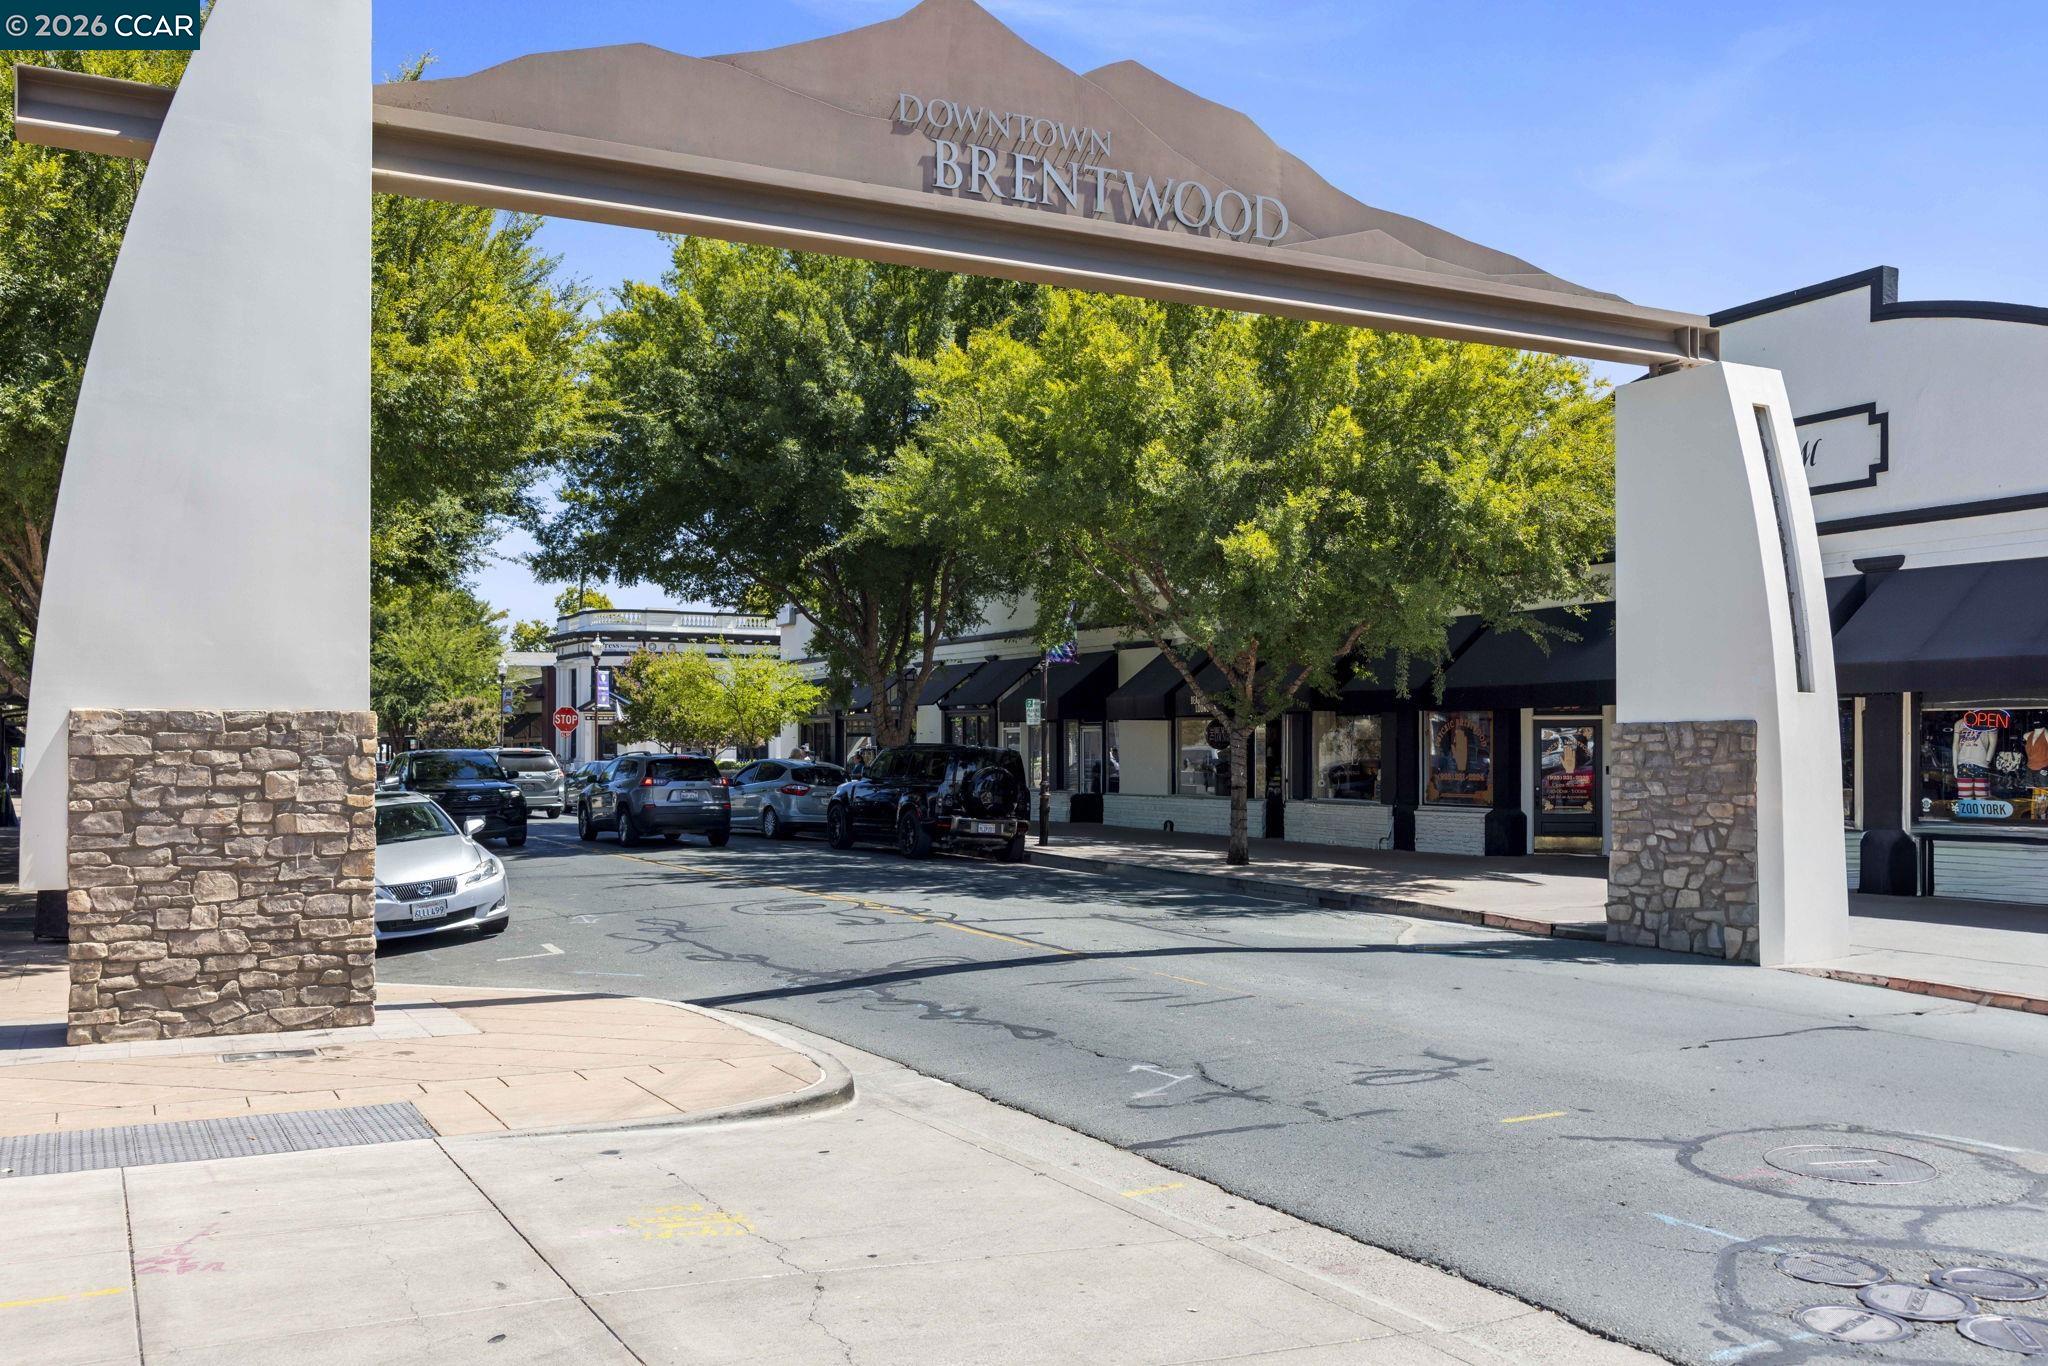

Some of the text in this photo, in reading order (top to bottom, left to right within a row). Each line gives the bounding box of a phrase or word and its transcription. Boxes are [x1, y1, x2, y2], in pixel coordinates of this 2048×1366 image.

[899, 93, 1112, 158] DOWNTOWN
[931, 137, 1290, 242] BRENTWOOD
[554, 714, 578, 725] STOP
[1963, 711, 2009, 728] OPEN
[1960, 803, 2007, 815] ZOO YORK
